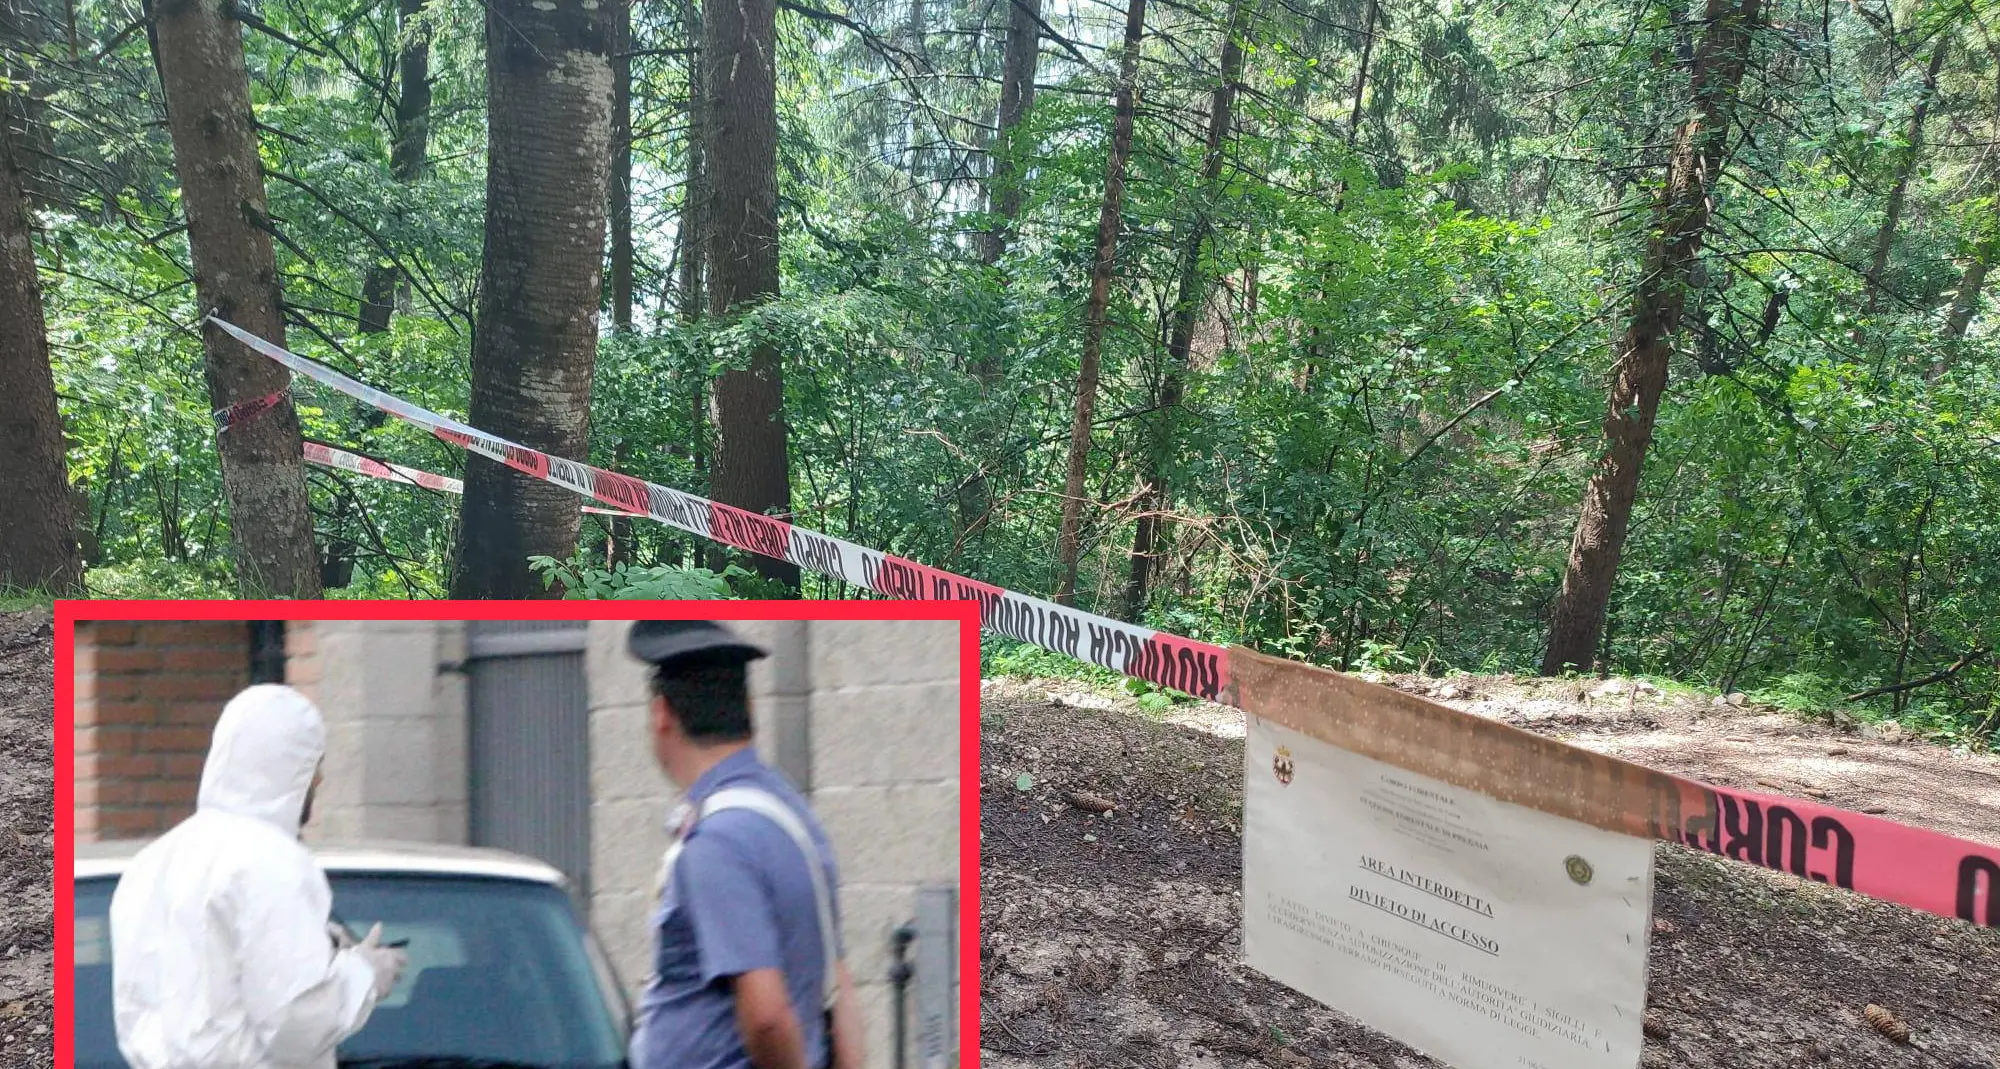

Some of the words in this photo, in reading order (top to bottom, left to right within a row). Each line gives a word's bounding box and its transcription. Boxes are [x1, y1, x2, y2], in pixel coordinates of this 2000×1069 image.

[716, 507, 791, 563] FORESTALE
[791, 529, 847, 582] CORPO
[1088, 621, 1219, 701] ROVINCIA
[1359, 853, 1395, 877] AREA
[1399, 868, 1493, 916] INTERDETTA
[1348, 884, 1408, 917] DIVIETO
[1411, 907, 1426, 924] DI
[1430, 916, 1499, 954] ACCESSO
[1357, 928, 1364, 938] A
[1370, 934, 1421, 962] CHIUNQUE
[1435, 959, 1446, 973] DI
[1461, 971, 1524, 1005] RIMUOVERE
[1543, 1005, 1585, 1032] SIGILLI
[1447, 990, 1486, 1015] NORMA
[1489, 1008, 1500, 1022] DI
